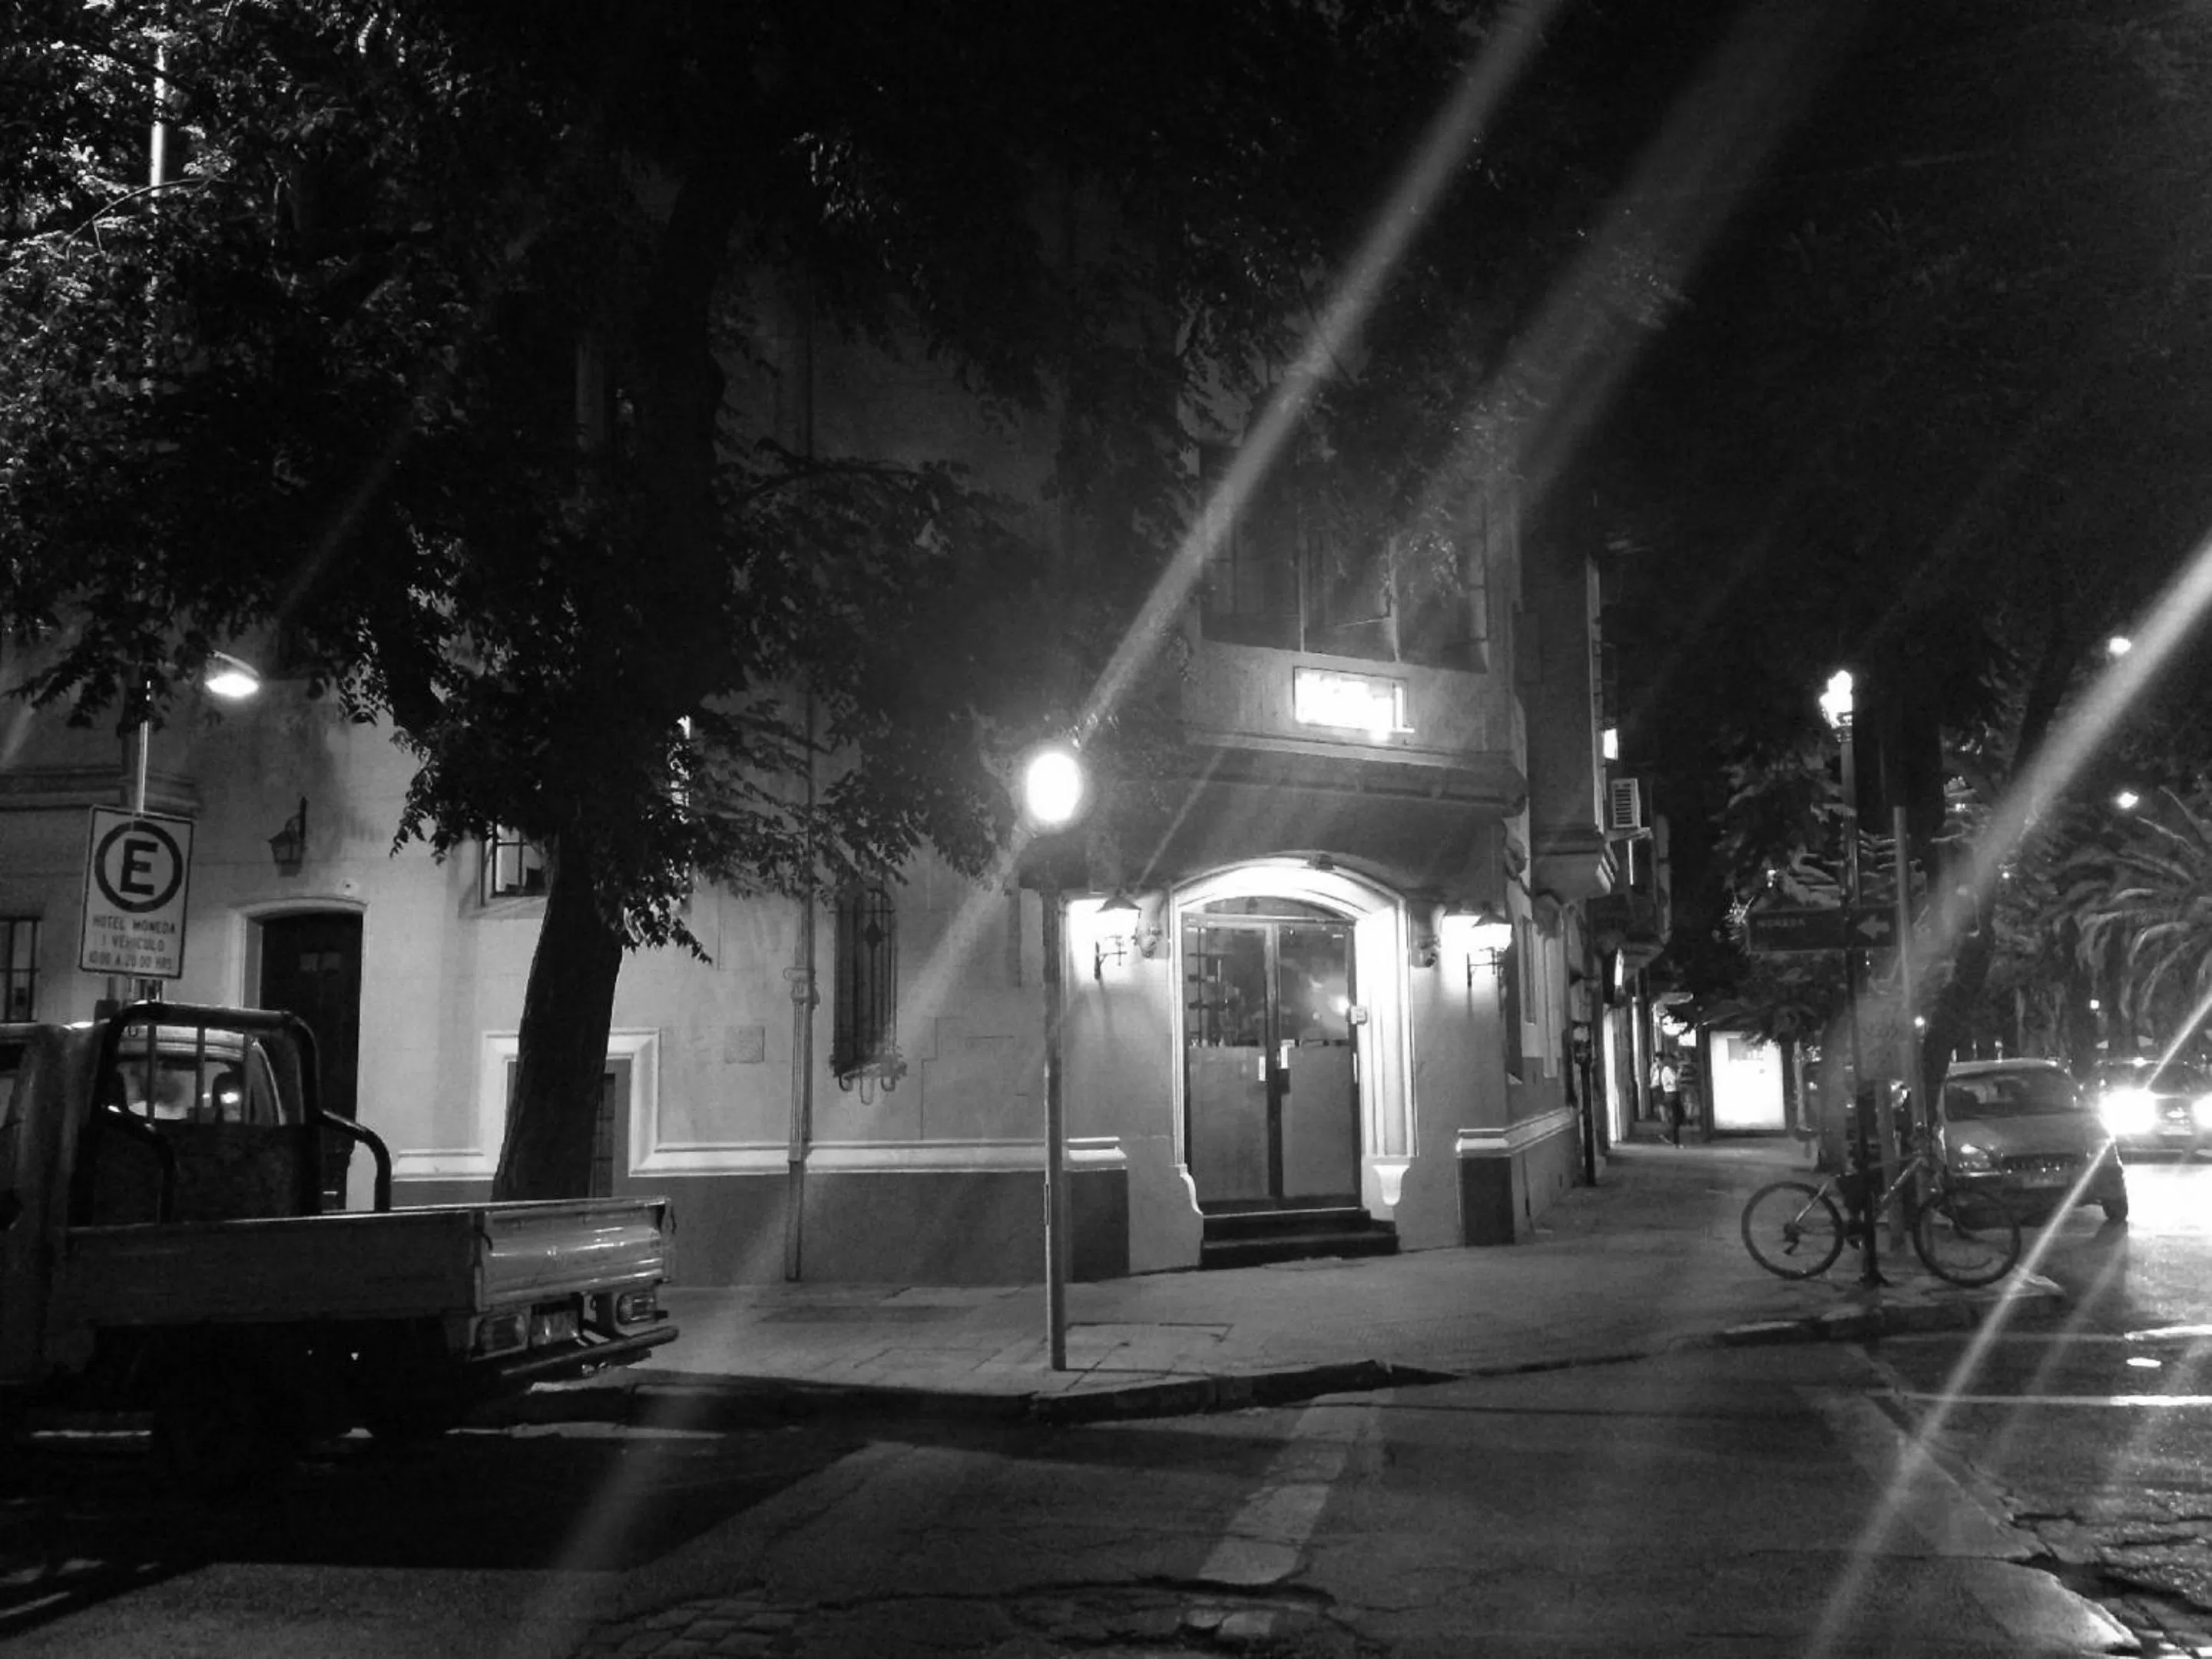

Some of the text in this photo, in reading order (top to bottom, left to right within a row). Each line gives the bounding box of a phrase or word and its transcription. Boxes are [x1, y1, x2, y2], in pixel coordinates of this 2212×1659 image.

[120, 839, 159, 896] E
[92, 915, 176, 935] HOTEL MONEDA
